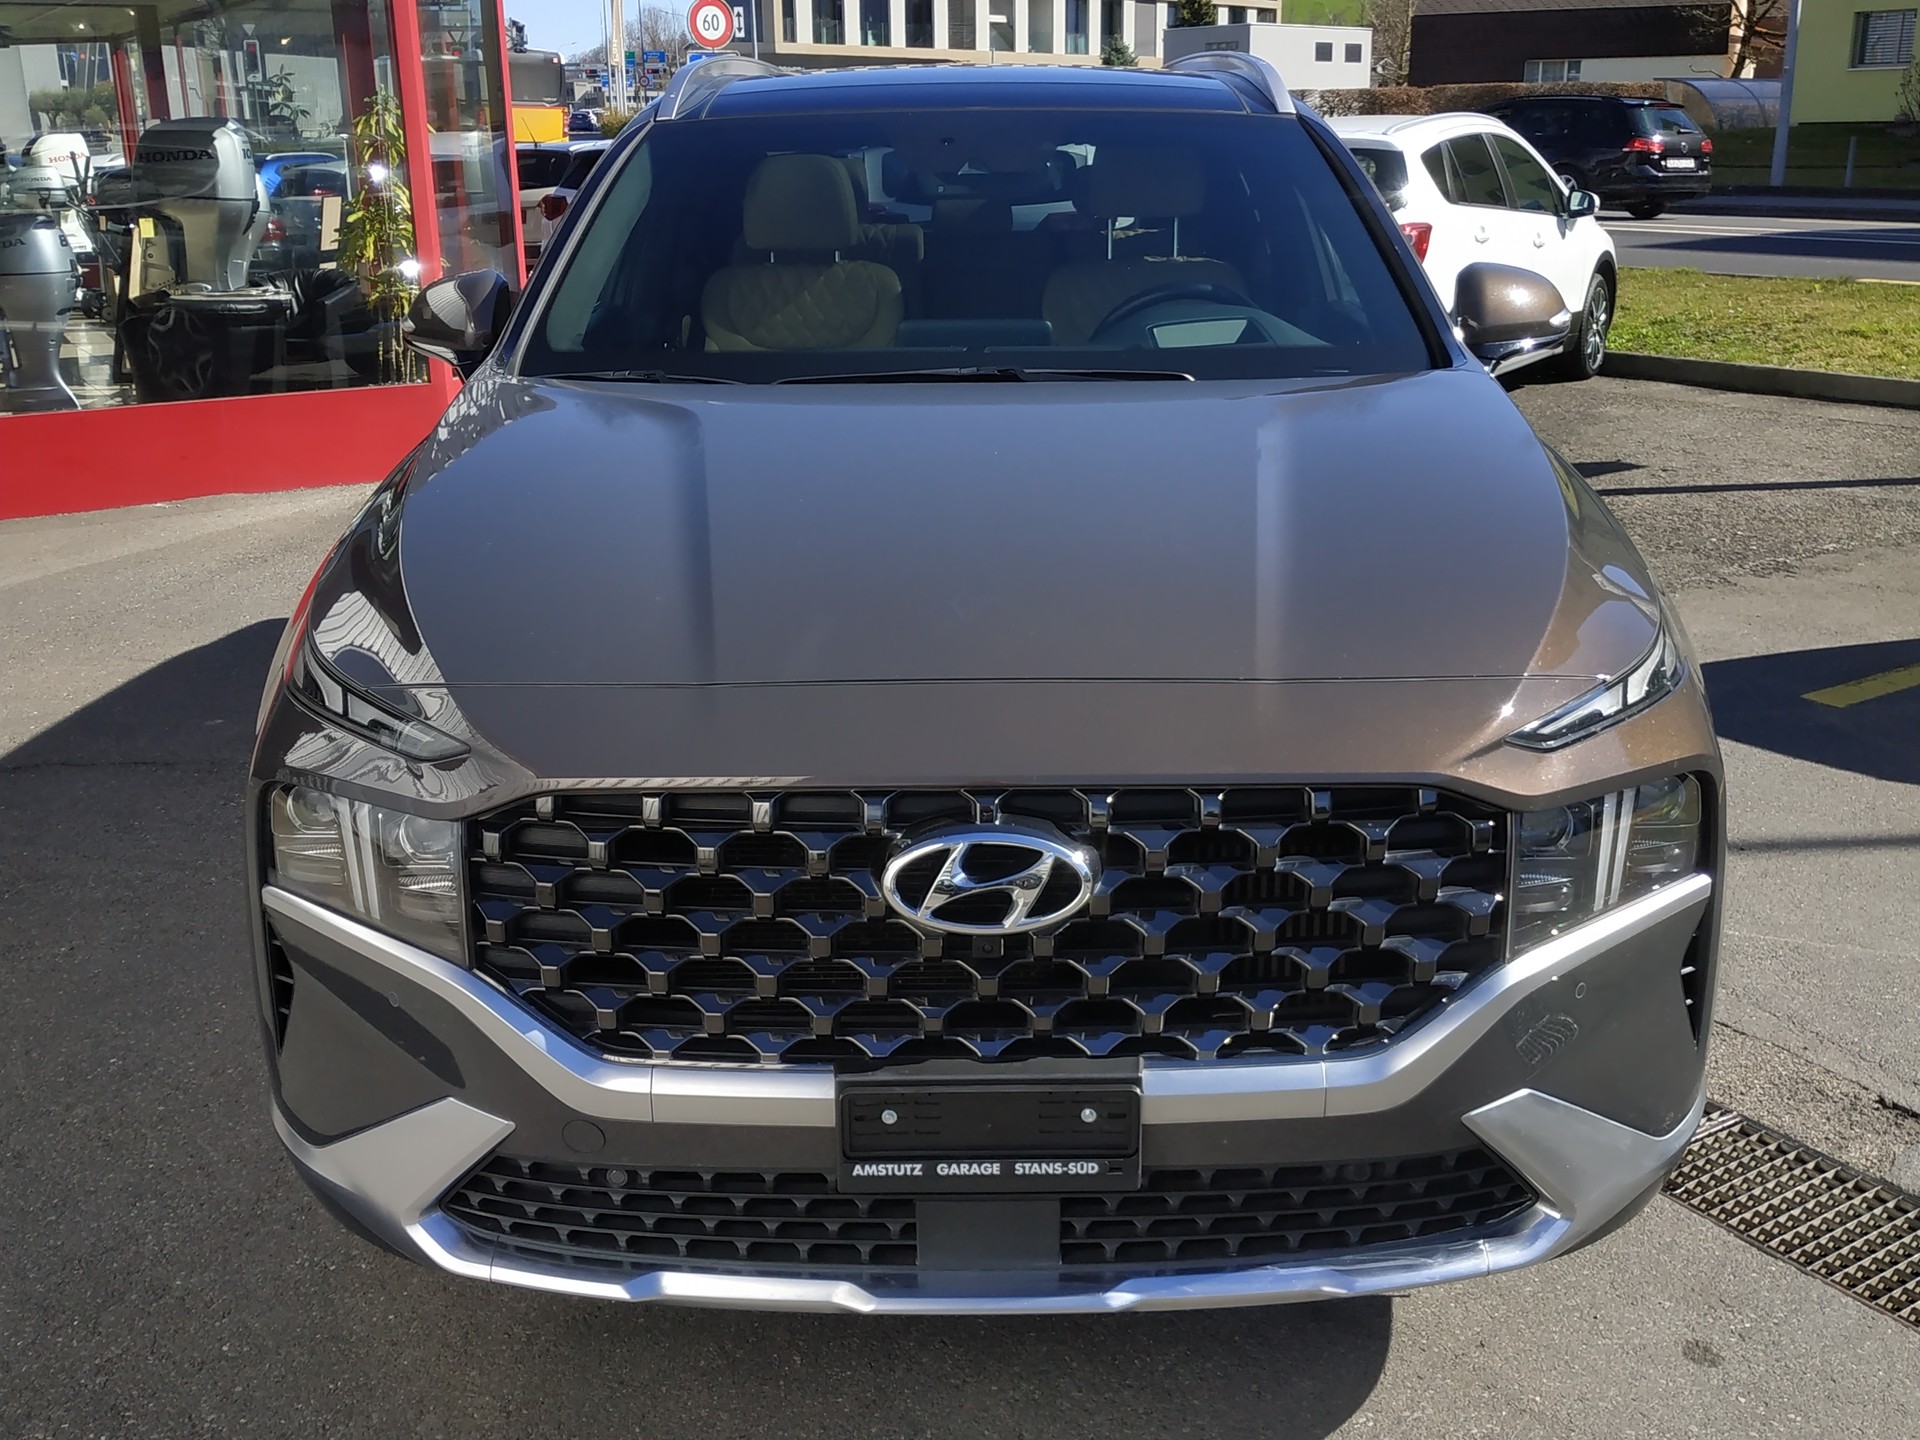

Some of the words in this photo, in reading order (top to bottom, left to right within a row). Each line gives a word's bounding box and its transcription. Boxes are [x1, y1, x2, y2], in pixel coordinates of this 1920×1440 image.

[703, 14, 719, 31] 60
[138, 149, 215, 163] HONDA
[852, 1163, 923, 1176] AMSTUTZ
[936, 1163, 1001, 1176] GARAGE
[1014, 1161, 1099, 1175] STANS-SÜD
